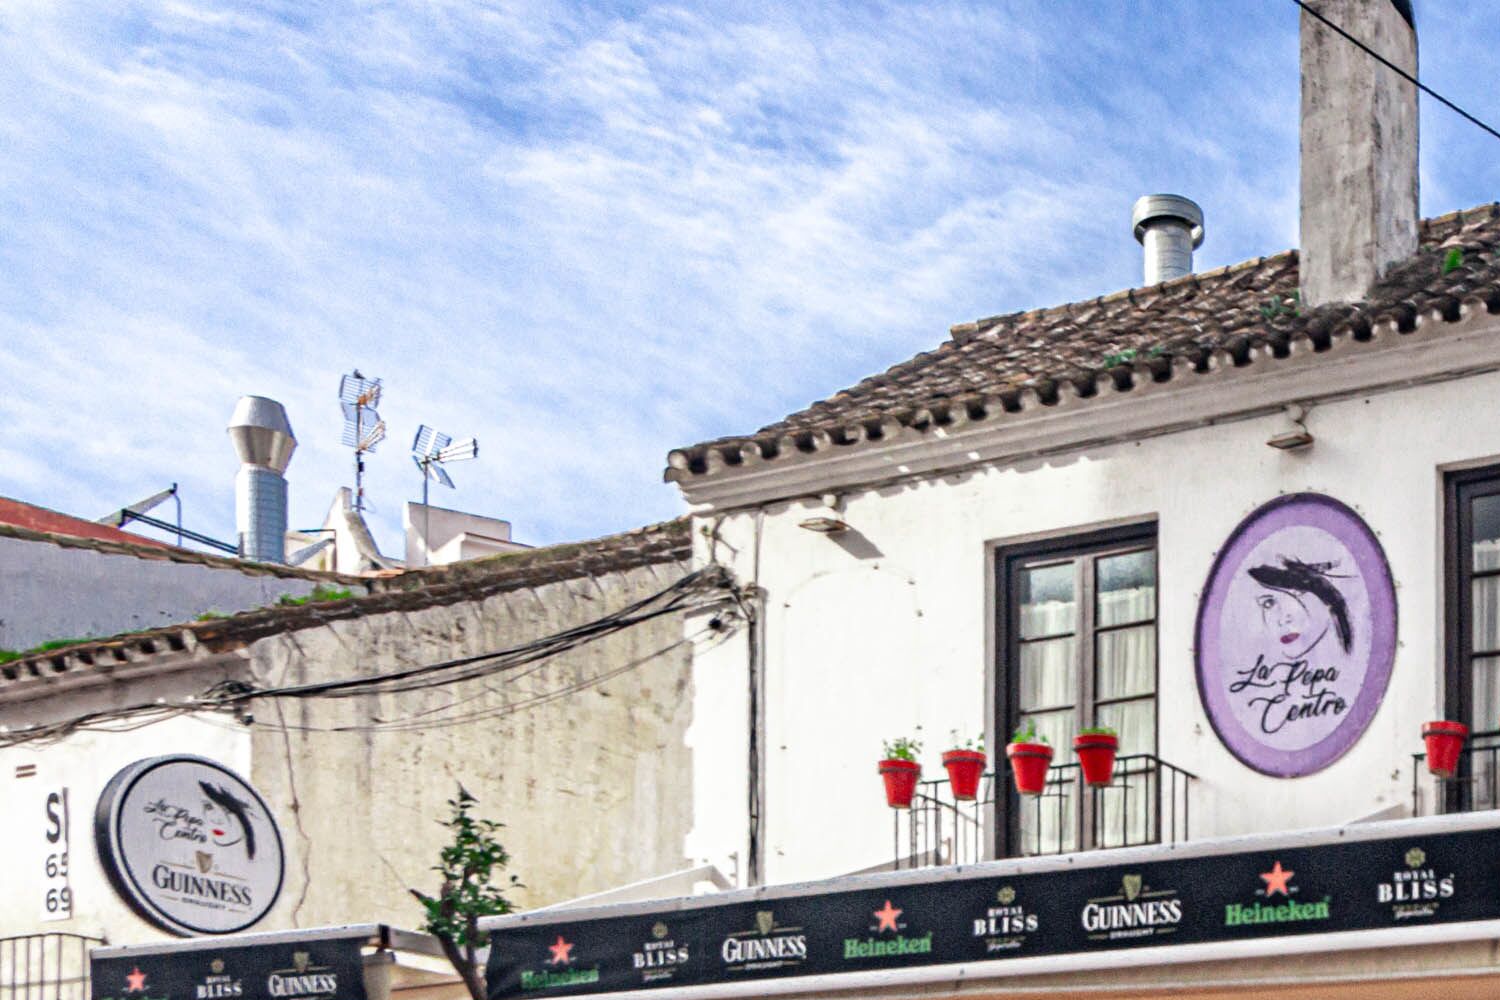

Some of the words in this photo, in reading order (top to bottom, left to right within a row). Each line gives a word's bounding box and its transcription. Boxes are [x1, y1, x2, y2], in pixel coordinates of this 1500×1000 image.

[1230, 654, 1276, 693] La
[1270, 660, 1339, 696] Pepa
[1248, 688, 1346, 734] Centro
[152, 863, 253, 907] GUINNESS
[1393, 868, 1436, 882] ROYAL
[1377, 877, 1455, 903] BLISS
[973, 914, 1039, 937] BLISS
[1081, 899, 1182, 932] GUINNESS
[1224, 899, 1330, 927] Heineken
[633, 947, 690, 969] BLISS
[722, 934, 807, 963] GUINNESS
[844, 934, 932, 959] Heineken
[196, 982, 243, 999] BLISS
[268, 973, 338, 997] GUINNESS
